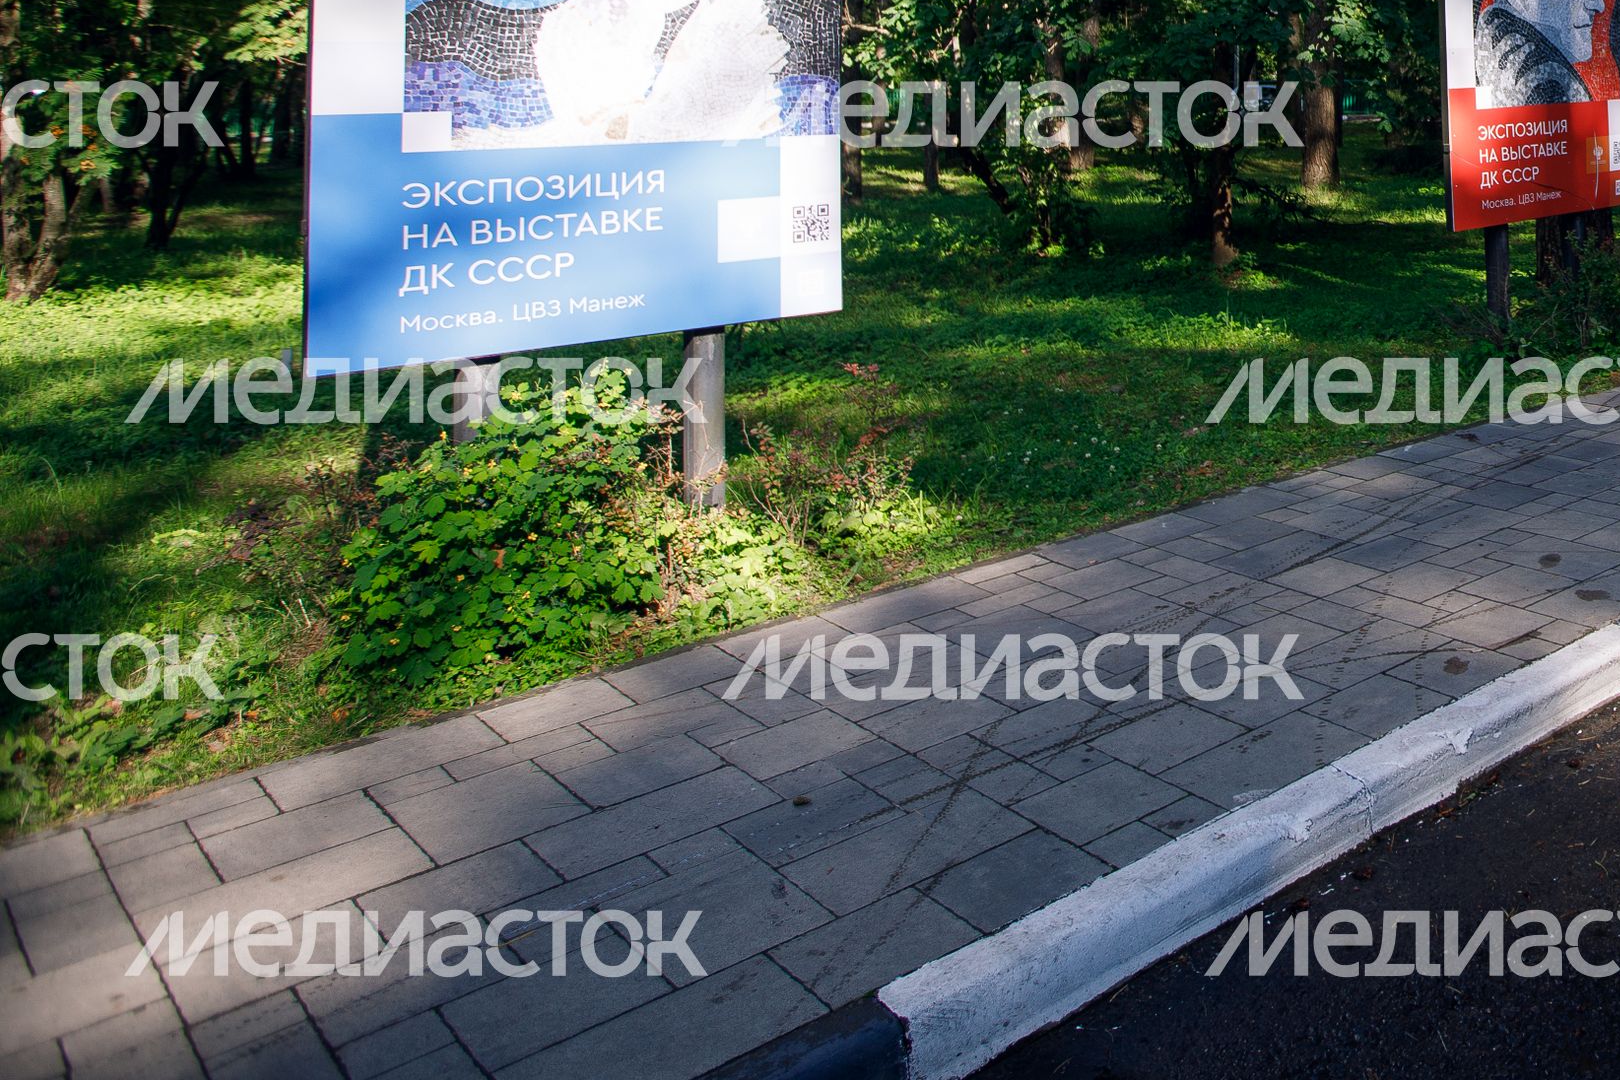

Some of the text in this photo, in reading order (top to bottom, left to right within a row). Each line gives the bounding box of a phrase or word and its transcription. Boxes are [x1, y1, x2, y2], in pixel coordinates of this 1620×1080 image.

[1478, 119, 1568, 141] ЭКСПОЗИЦИЯ
[1480, 141, 1568, 164] НА ВЫСТАВКЕ
[401, 169, 665, 209] ЭКСПОЗИЦИЯ
[1480, 166, 1540, 190] ДК СССР
[1481, 197, 1517, 210] Москва.
[1536, 190, 1562, 201] Манеж
[402, 206, 664, 250] НА ВЫСТАВКЕ
[398, 252, 575, 297] ДК СССР
[400, 293, 646, 334] Москва. ЦВЗ Манеж
